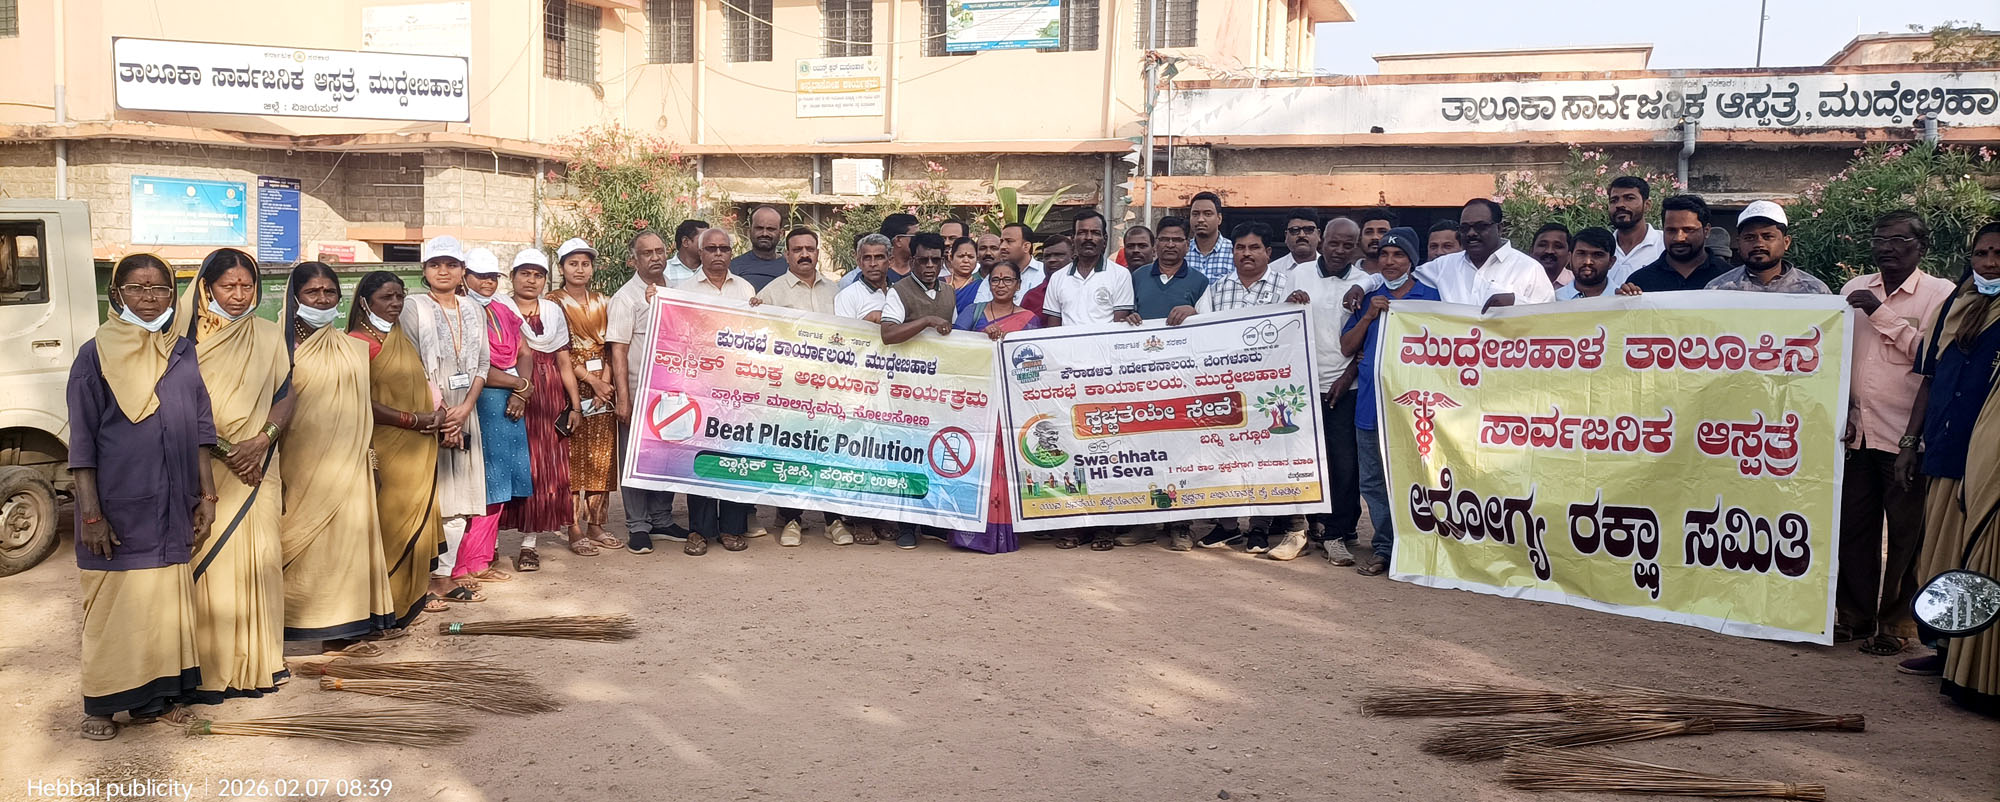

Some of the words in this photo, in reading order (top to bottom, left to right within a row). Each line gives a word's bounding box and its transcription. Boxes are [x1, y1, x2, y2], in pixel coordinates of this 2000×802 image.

[119, 62, 202, 85] ತಾಲೂಕಾ
[212, 63, 304, 91] ಸಾರ್ವಜನಿಕ
[368, 70, 464, 107] ಮುದ್ದೇಬಿಹಾಳ
[1441, 95, 1557, 122] ತಾಲೂಕಾ
[1561, 84, 1708, 120] ಸಾರ್ವಜನಿಕ
[1716, 82, 1812, 126] ಆಸ್ಪತ್ರೆ,
[1818, 80, 2000, 124] ಮುದ್ದೇಬಿಹಾ
[291, 103, 339, 112] ವಿಜಯಪುರ
[1388, 236, 1398, 244] K
[717, 328, 767, 354] ಪುರಸಭೆ
[774, 340, 857, 368] ಕಾರ್ಯಾಲಯ,
[865, 352, 938, 379] ಮುದ್ದೇಬಿಹಾಳ
[1060, 364, 1113, 380] ಪೌರಾಡಳಿತ
[1204, 351, 1262, 368] ಬೆಂಗಳೂರು
[1401, 326, 1606, 387] ಮುದ್ದೇಬಿಹಾಳ
[1625, 326, 1821, 373] ತಾಲೂಕಿನ
[654, 350, 726, 378] ಪ್ಲಾಸ್ಟಿಕ್
[735, 361, 784, 387] ಮುಕ್ತ
[794, 370, 880, 396] ಅಭಿಯಾನ
[890, 383, 989, 411] ಕಾರ್ಯಕ್ರಮ
[1022, 383, 1077, 401] ಪುರಸಭೆ
[1194, 364, 1292, 390] ಮುದ್ದೇಬಿಹಾಳ
[711, 388, 760, 408] ಪ್ಲಾಸ್ಟಿಕ್
[766, 394, 846, 420] ಮಾಲಿನ್ಯವನ್ನು
[853, 405, 930, 426] ಸೋಲಿಸೋಣ
[1185, 396, 1232, 419] ಸೇವೆ
[704, 417, 754, 442] Beat
[758, 423, 830, 452] Plastic
[834, 433, 924, 464] Pollution
[1200, 432, 1224, 447] ಬನ್ನಿ
[1229, 429, 1271, 445] ಒಗ್ಗೂಡಿ
[1481, 406, 1674, 453] ಸಾರ್ವಜನಿಕ
[1698, 410, 1801, 477] ಆಸ್ಪತ್ರೆ
[718, 456, 767, 476] ಪ್ಲಾಸ್ಟಿಕ್
[820, 466, 865, 484] ಪರಿಸರ
[870, 475, 908, 489] ಉಳಿಸಿ
[1073, 449, 1168, 466] Swachhata
[1090, 466, 1108, 480] Hi
[1112, 466, 1154, 478] Seva
[1176, 464, 1194, 473] ಗಂಟೆ
[1292, 457, 1314, 466] ಮಾಡಿ
[1409, 467, 1552, 581] ಆರೋಗ್ಯ
[1568, 489, 1662, 599] ರಕ್ಷಾ
[1684, 497, 1812, 577] ಸಮಿತಿ
